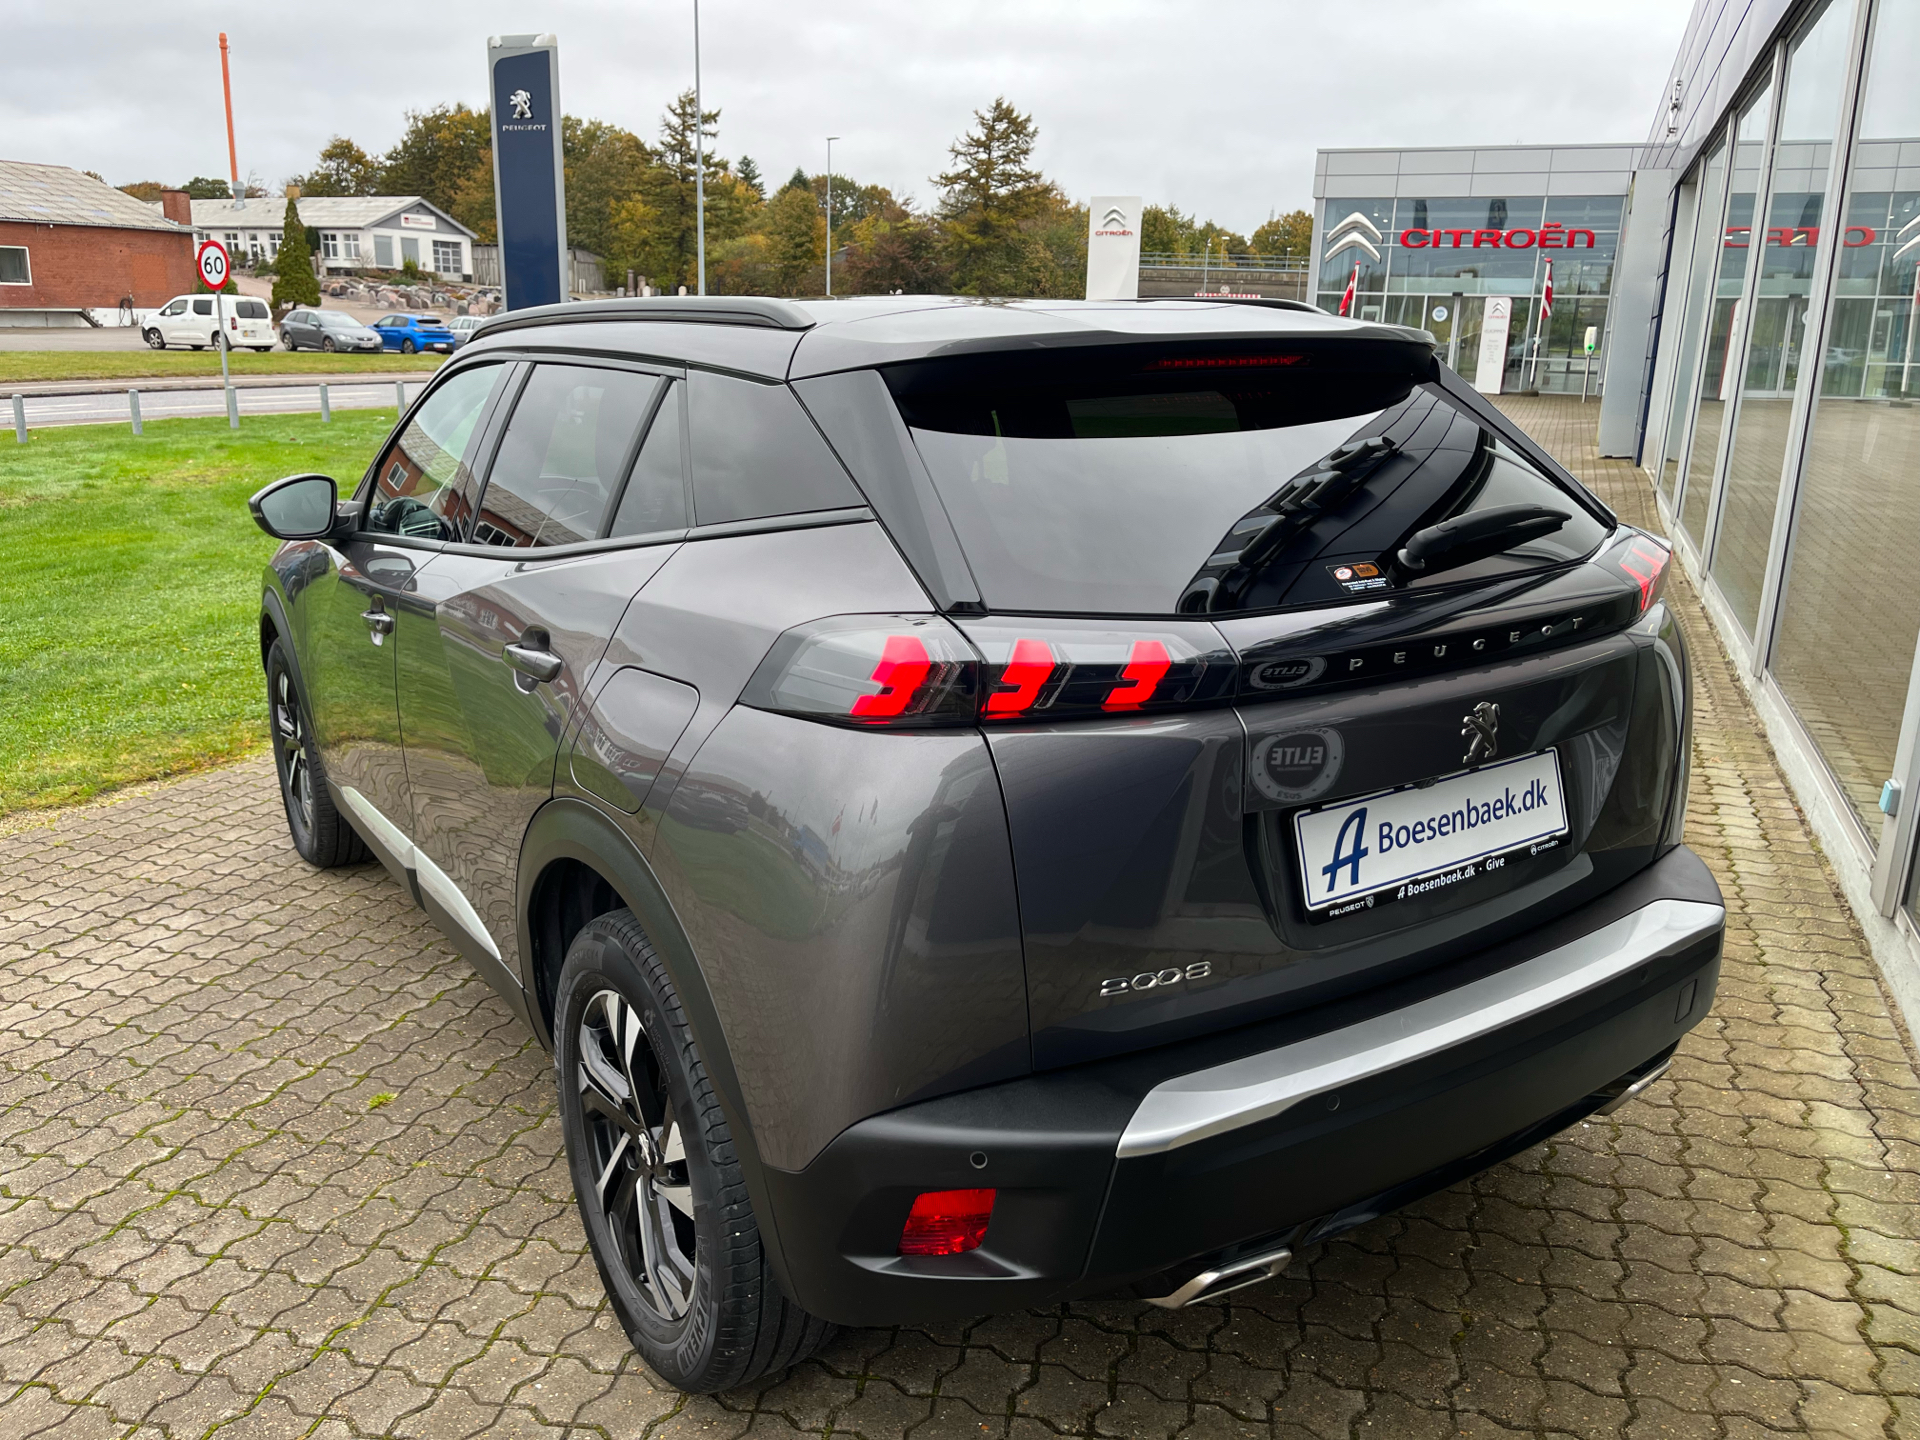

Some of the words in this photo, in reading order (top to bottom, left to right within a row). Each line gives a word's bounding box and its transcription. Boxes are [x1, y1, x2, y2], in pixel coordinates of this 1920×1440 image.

[502, 124, 547, 132] PEUGEOT
[1400, 222, 1596, 249] CITROËN
[204, 256, 223, 275] 60
[1349, 617, 1584, 672] PEUGEOT
[1321, 807, 1369, 893] A
[1378, 778, 1549, 854] Boesenbaek.dk
[1407, 865, 1476, 897] Boesenbaek.dk
[1485, 857, 1505, 871] Give
[1329, 901, 1366, 917] PEUGEOT
[1099, 961, 1212, 997] 2008
